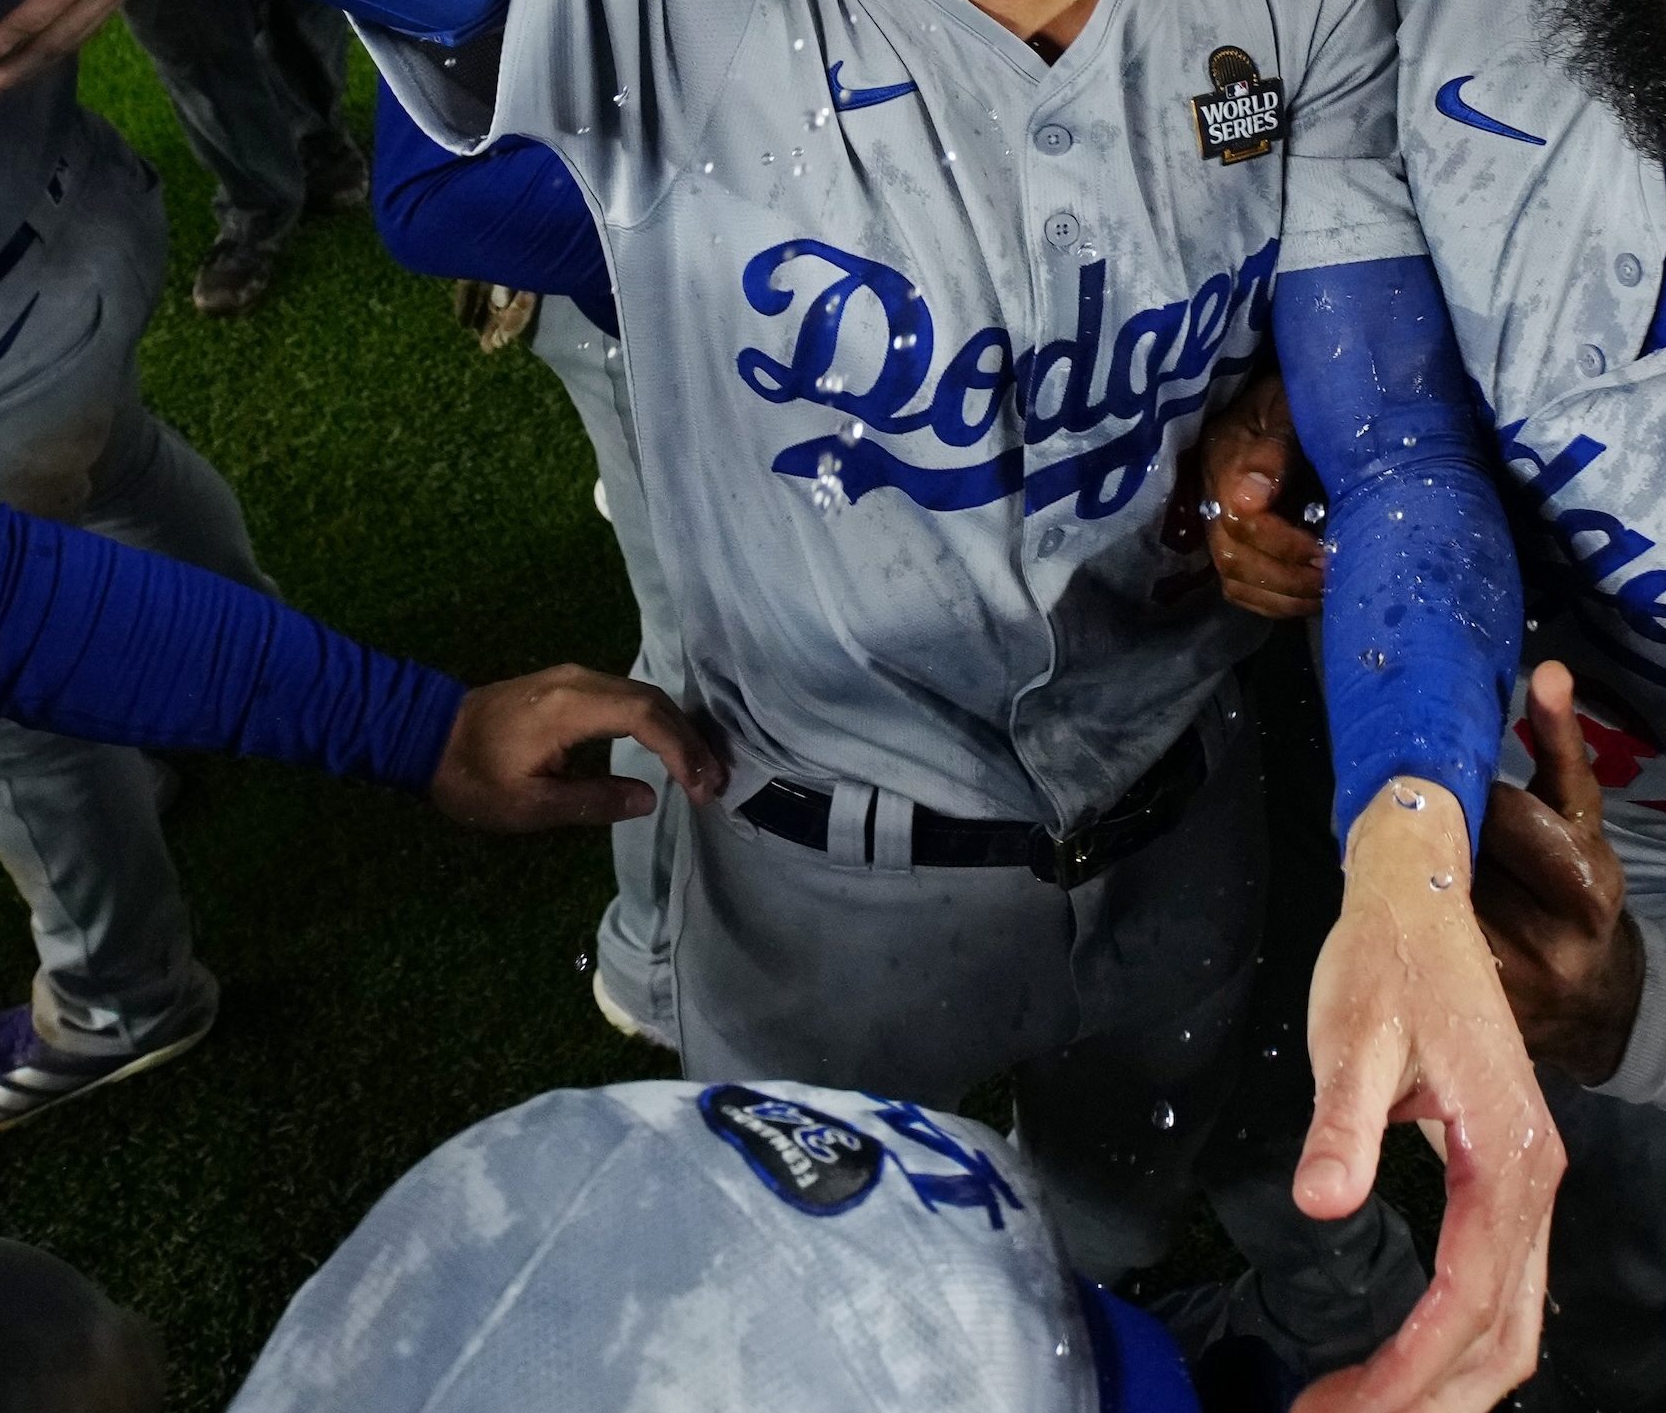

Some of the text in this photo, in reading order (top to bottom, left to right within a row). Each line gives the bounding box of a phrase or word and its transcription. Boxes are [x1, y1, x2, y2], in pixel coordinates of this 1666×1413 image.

[1200, 91, 1279, 126] WORLD
[1208, 110, 1279, 145] SERIES
[737, 238, 1280, 520] Dodger
